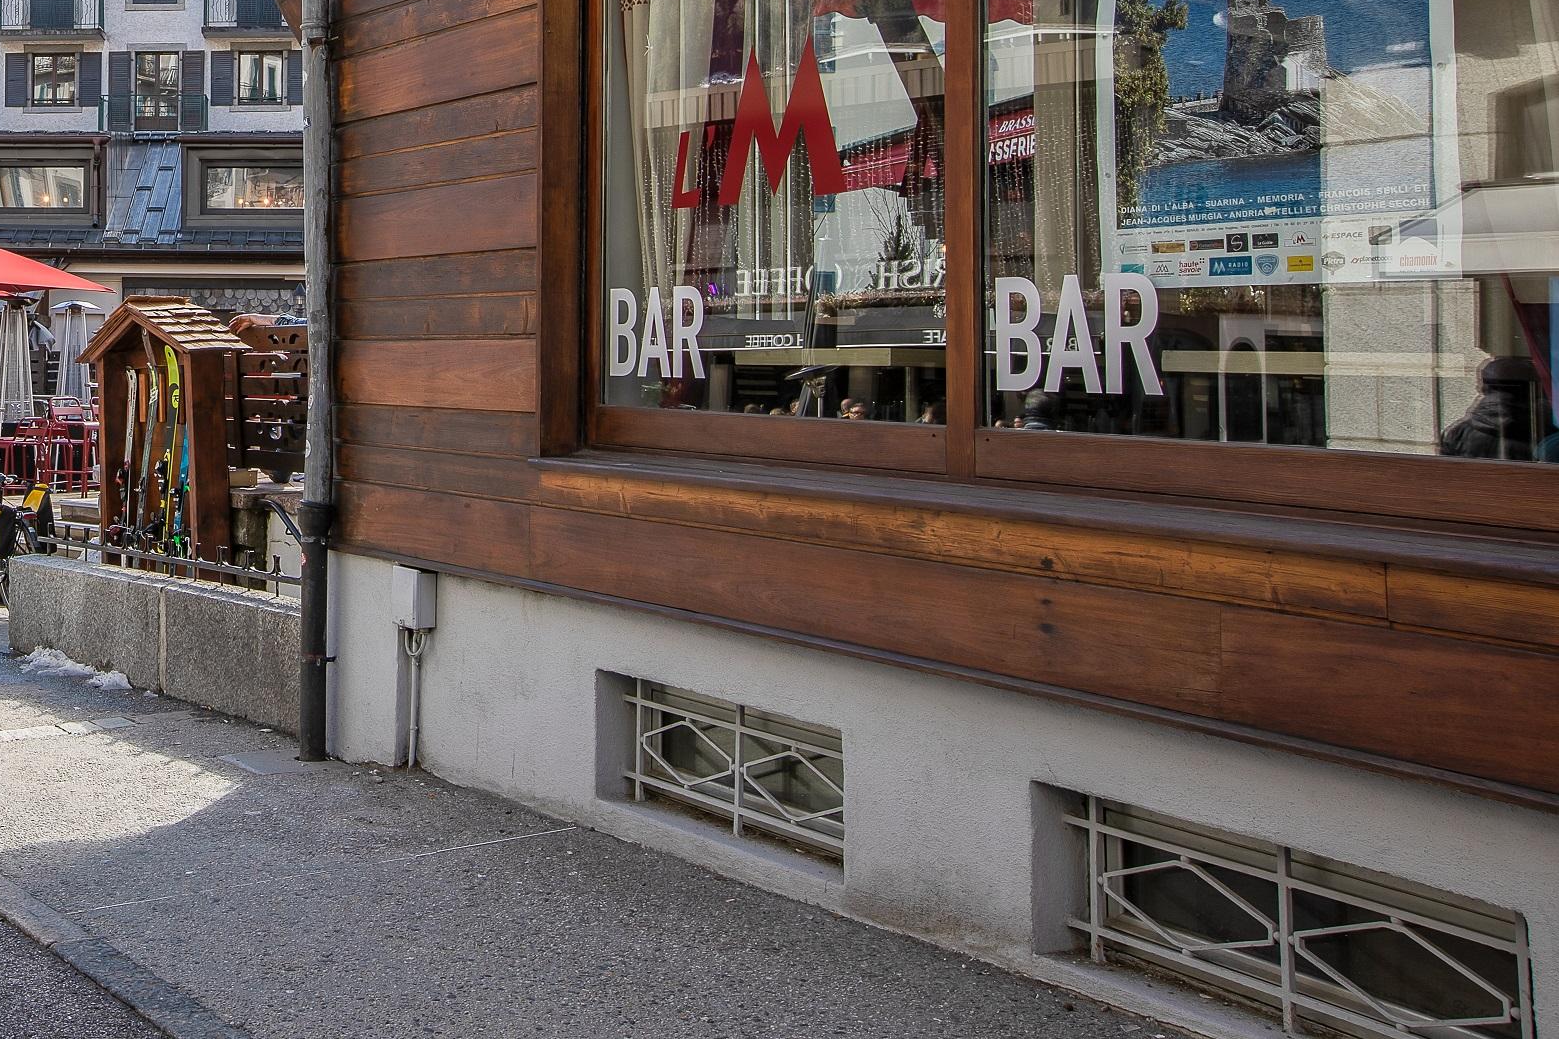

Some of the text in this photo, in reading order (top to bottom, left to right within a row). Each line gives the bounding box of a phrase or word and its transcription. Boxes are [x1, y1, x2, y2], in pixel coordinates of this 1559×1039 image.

[1120, 205, 1147, 215] DIANA
[1151, 204, 1161, 213] DI
[1164, 201, 1195, 211] L'ALBA
[1205, 197, 1245, 209] SUARINA
[1257, 192, 1305, 204] MEMORIA
[1414, 183, 1428, 193] ET
[1120, 213, 1187, 227] JEAN-JACQUES
[1188, 211, 1223, 222] MURGIA
[1229, 209, 1264, 219] ANDRIA
[1305, 205, 1318, 214] ET
[1319, 200, 1386, 213] CHRISTOPHE
[1388, 197, 1430, 208] SECCHI
[1331, 231, 1364, 239] ESPACE
[1178, 260, 1199, 268] haute
[1178, 266, 1202, 274] savoie
[1399, 254, 1438, 267] chamonix
[608, 285, 706, 380] BAR
[995, 272, 1165, 396] BAR
